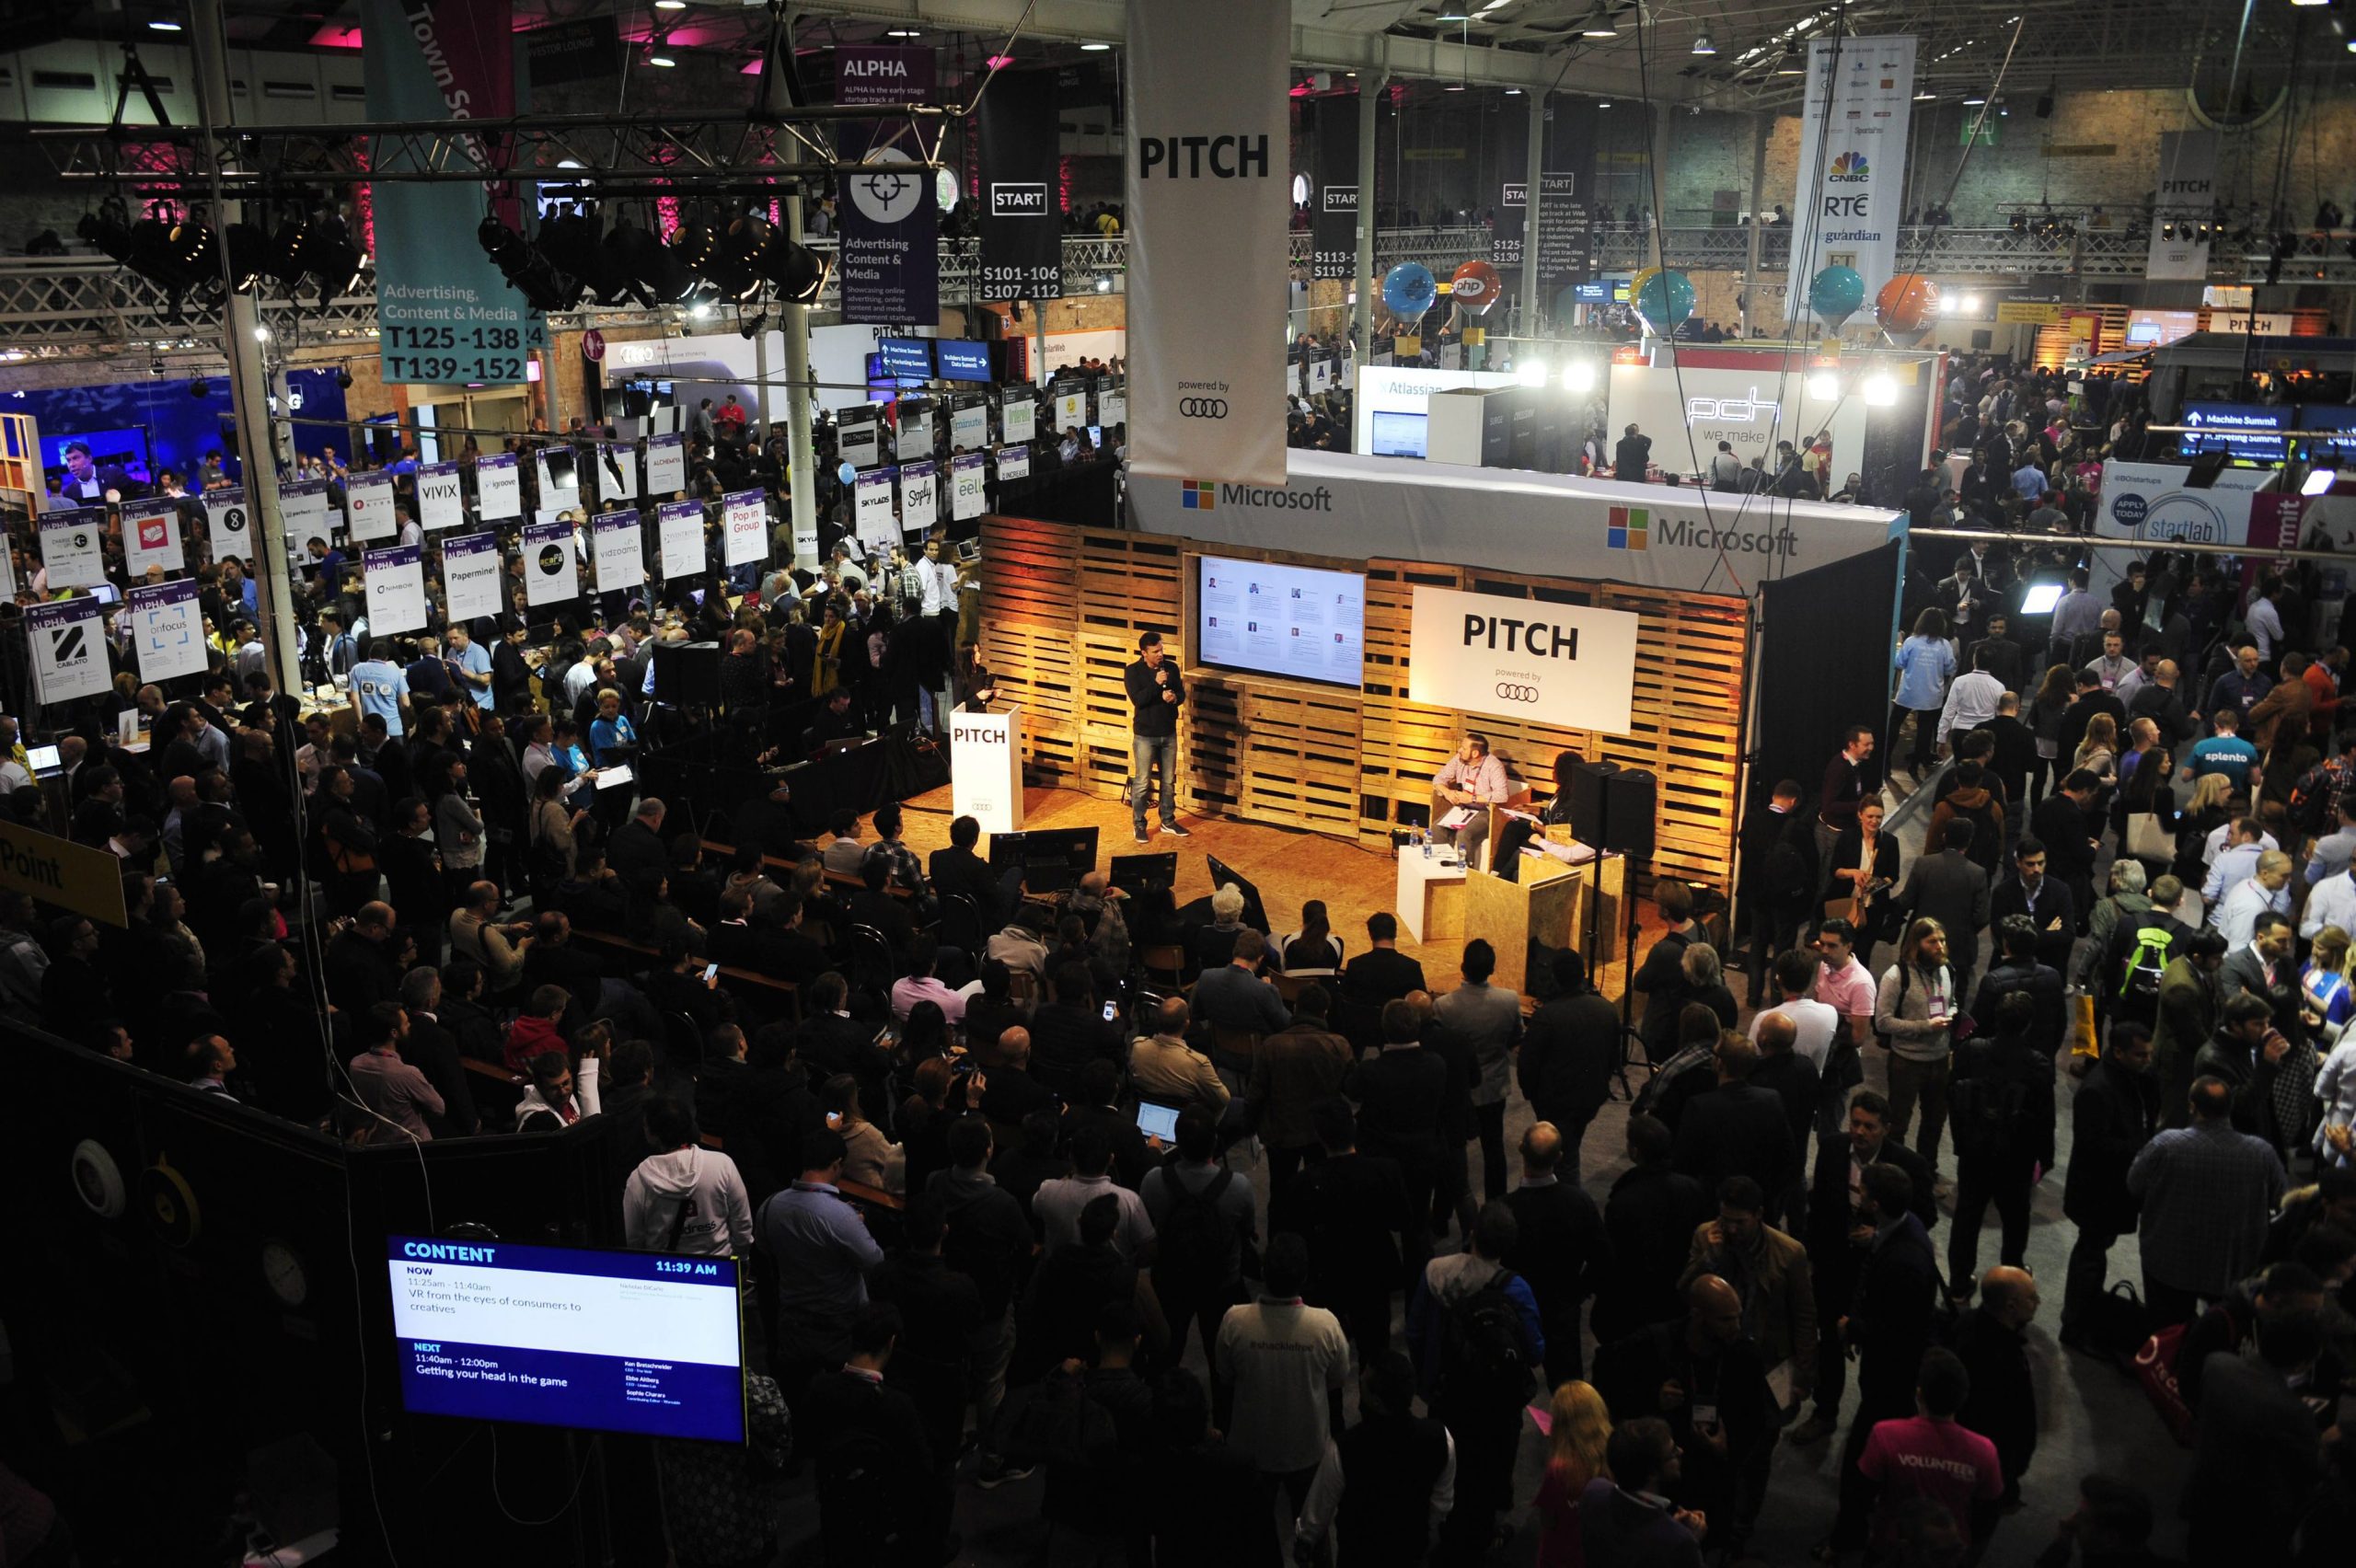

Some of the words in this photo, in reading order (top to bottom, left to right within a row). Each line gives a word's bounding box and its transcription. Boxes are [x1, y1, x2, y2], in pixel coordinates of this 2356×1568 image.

[408, 3, 454, 87] Town
[844, 60, 907, 77] ALPHA
[889, 86, 907, 96] early
[908, 87, 925, 97] stage
[845, 96, 869, 104] startup
[1140, 135, 1268, 179] PITCH
[2163, 180, 2210, 193] PITCH
[996, 192, 1044, 206] START
[1327, 194, 1358, 204] STAR
[1506, 190, 1528, 200] STA
[1824, 193, 1868, 216] RTÉ
[846, 237, 909, 251] Advertising
[846, 254, 890, 265] Content
[893, 254, 902, 265] &
[846, 268, 880, 280] Media
[984, 266, 1058, 282] S101-106
[1314, 266, 1345, 277] S119
[384, 284, 479, 303] Advertising,
[847, 285, 883, 295] Showcasing
[884, 286, 906, 294] online
[1455, 282, 1480, 293] php
[885, 295, 905, 304] online
[385, 305, 450, 319] Content
[454, 306, 465, 320] &
[469, 307, 517, 321] Media
[847, 313, 887, 324] management
[889, 313, 916, 323] startups
[1178, 380, 1218, 390] powered
[1219, 382, 1230, 393] by
[1389, 381, 1443, 395] Atlassian
[2206, 414, 2243, 425] Machine
[2244, 416, 2277, 427] Summit
[1703, 430, 1723, 441] we
[1727, 429, 1765, 443] make
[650, 442, 666, 451] ALPHA
[479, 464, 498, 473] ALPHA
[1005, 469, 1027, 478] INCREASE
[420, 471, 439, 480] ALPHA
[904, 472, 920, 481] ALPHA
[350, 482, 371, 491] ALPHA
[492, 478, 516, 490] igroove
[858, 479, 875, 490] ALPHA
[282, 490, 305, 501] ALPHA
[422, 484, 457, 500] VIVIX
[1222, 482, 1333, 513] Microsoft
[210, 500, 234, 510] ALPHA
[726, 502, 746, 512] ALPHA
[860, 495, 890, 507] SKYLADS
[2118, 500, 2145, 510] APPLY
[125, 511, 151, 522] ALPHA
[662, 513, 683, 523] ALPHA
[733, 512, 748, 522] Pop
[751, 509, 759, 518] in
[2116, 510, 2145, 519] TODAY
[42, 521, 70, 532] ALPHA
[596, 524, 618, 535] ALPHA
[733, 522, 759, 534] Group
[2150, 518, 2213, 542] startlab
[527, 535, 551, 547] ALPHA
[1658, 518, 1798, 558] Microsoft
[447, 549, 473, 560] ALPHA
[367, 559, 395, 572] ALPHA
[451, 566, 495, 582] Papermine!
[386, 582, 413, 592] NIMBOW
[133, 598, 167, 614] ALPHA
[86, 609, 96, 617] 150
[32, 617, 66, 631] ALPHA
[151, 620, 187, 634] onfocus
[1464, 614, 1578, 661] PITCH
[57, 658, 88, 669] CABLATO
[1496, 668, 1530, 679] powered
[1532, 674, 1542, 683] by
[954, 728, 1005, 744] PITCH
[2205, 752, 2247, 762] splento
[0, 837, 63, 890] Point
[404, 1242, 495, 1263] CONTENT
[407, 1266, 433, 1276] NOW
[656, 1261, 691, 1273] 11:39
[695, 1264, 717, 1275] AM
[408, 1277, 445, 1289] 11:25am
[454, 1281, 491, 1292] 11:40am
[409, 1289, 424, 1299] VR
[426, 1290, 451, 1301] from
[454, 1293, 471, 1303] the
[473, 1296, 497, 1307] eyes
[499, 1296, 510, 1306] of
[512, 1298, 568, 1311] consumers
[571, 1301, 582, 1311] to
[410, 1302, 456, 1314] creatives
[414, 1343, 441, 1353] NEXT
[416, 1354, 453, 1366] 11:40am
[461, 1357, 499, 1369] 12:00pm
[416, 1365, 455, 1379] Getting
[456, 1369, 479, 1381] your
[481, 1370, 506, 1382] head
[509, 1372, 518, 1382] in
[521, 1374, 537, 1385] the
[540, 1378, 568, 1389] game
[627, 1389, 644, 1398] Sophie
